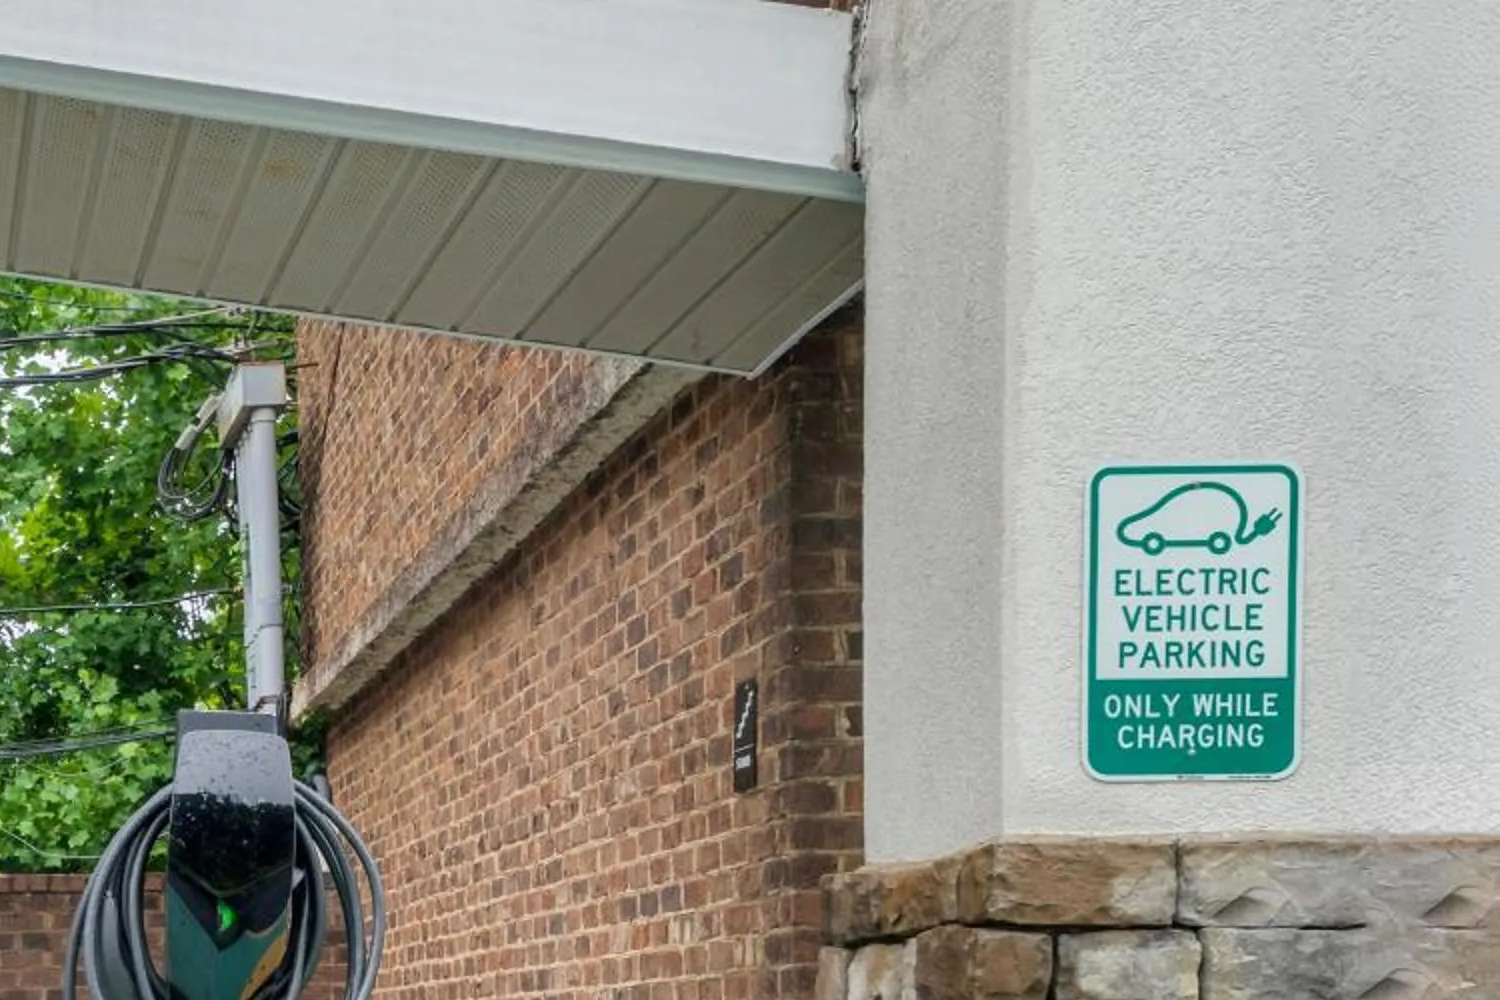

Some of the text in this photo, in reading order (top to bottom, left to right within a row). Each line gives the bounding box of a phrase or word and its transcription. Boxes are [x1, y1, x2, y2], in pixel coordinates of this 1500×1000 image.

[1114, 567, 1270, 597] ELECTRIC
[1122, 603, 1263, 632] VEHICLE
[1118, 640, 1265, 668] PARKING
[1104, 693, 1279, 719] ONLY WHILE
[1117, 724, 1264, 749] CHARGING
